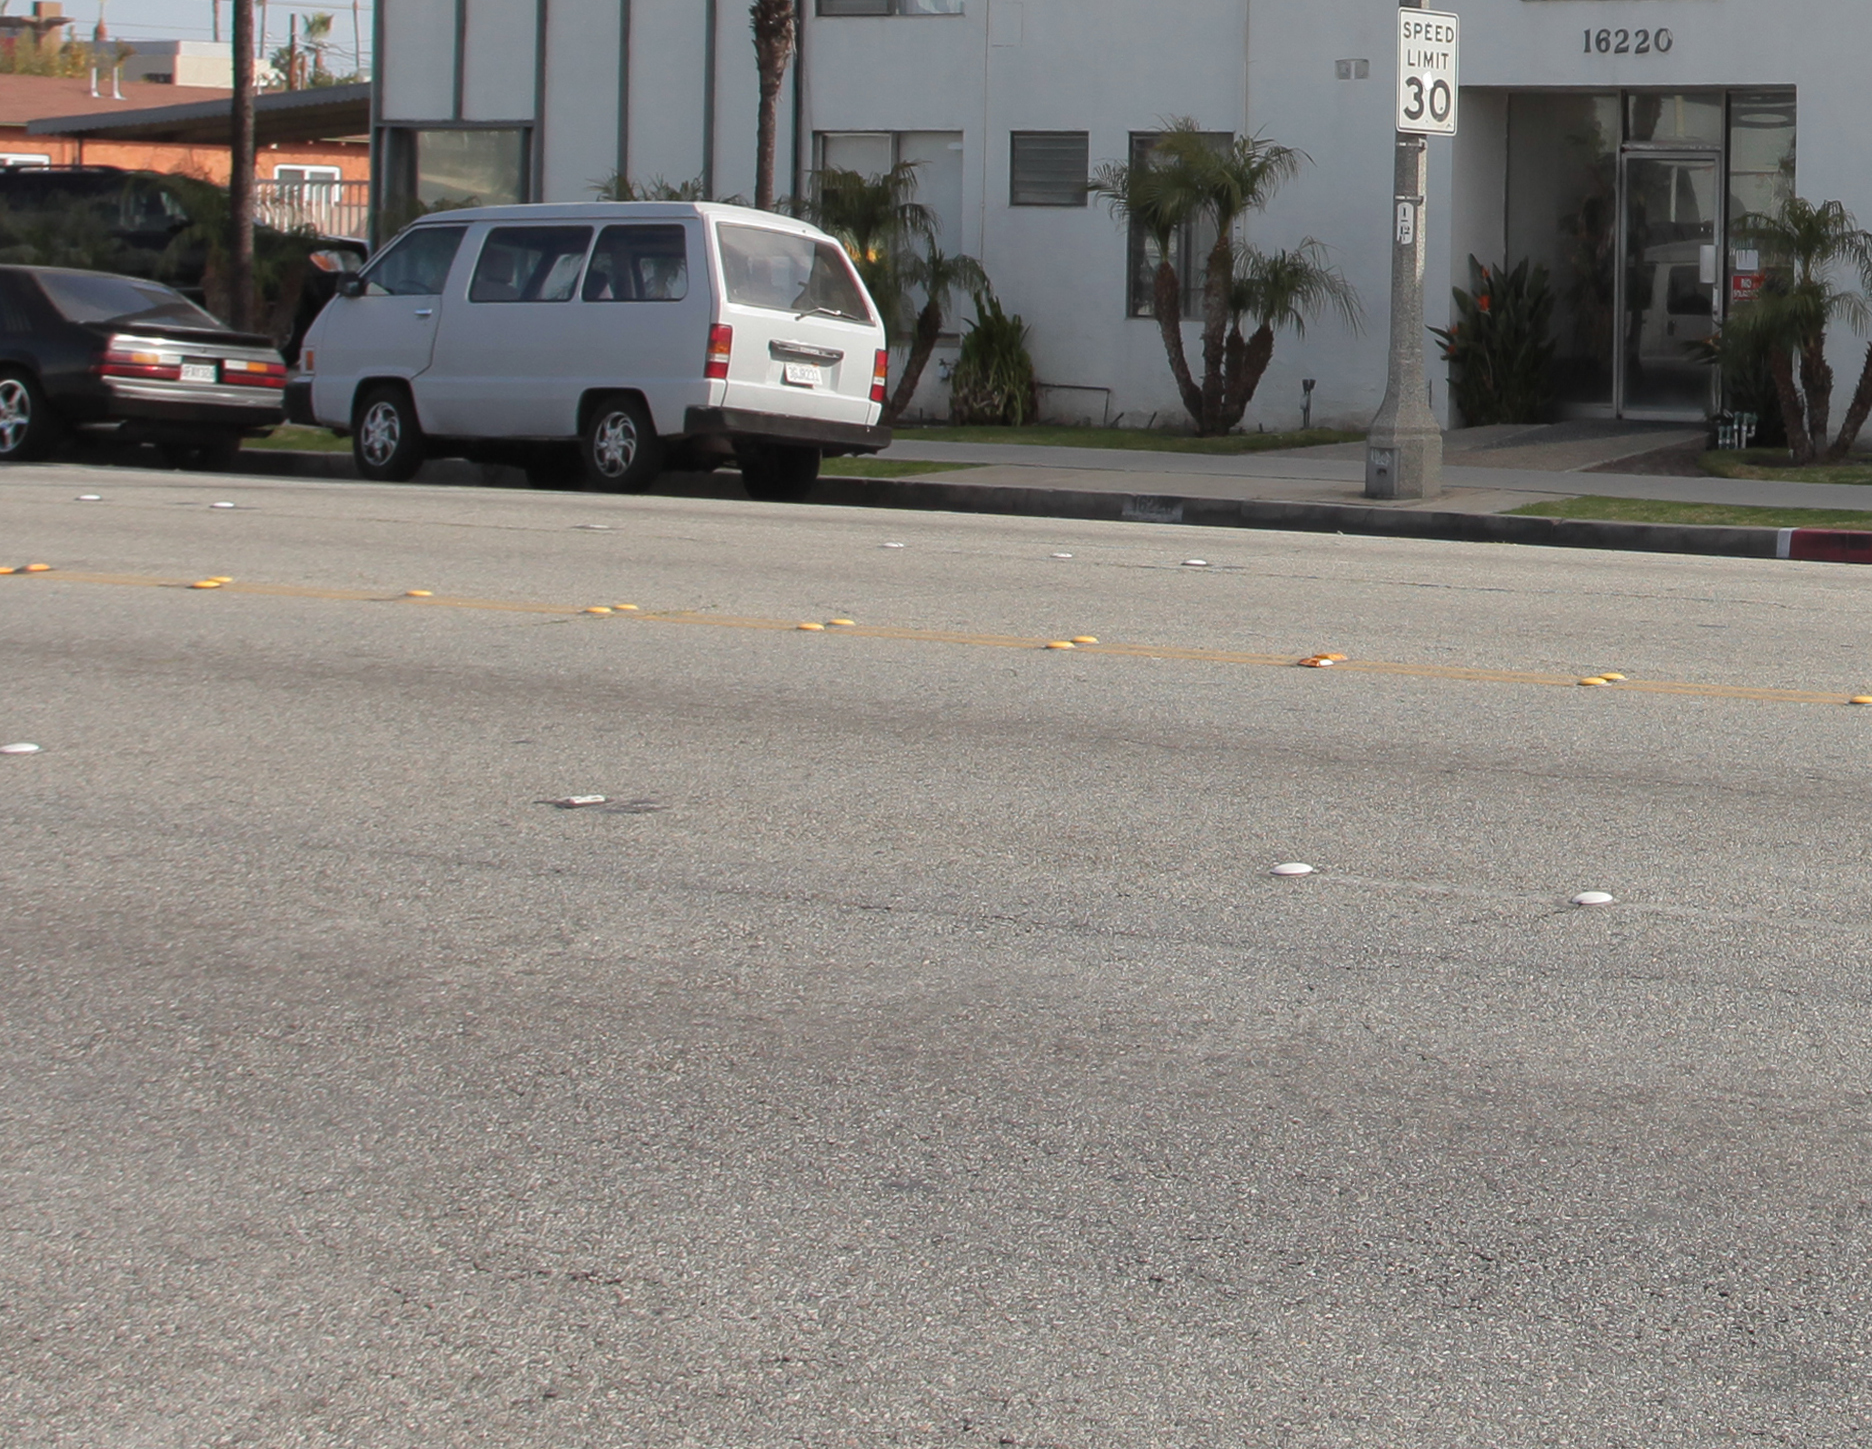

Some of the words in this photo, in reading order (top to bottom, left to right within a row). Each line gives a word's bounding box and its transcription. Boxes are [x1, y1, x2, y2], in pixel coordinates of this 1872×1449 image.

[1403, 21, 1455, 44] SPEED
[1583, 27, 1674, 54] 16220
[1407, 49, 1450, 70] LIMIT
[1403, 76, 1452, 124] 30
